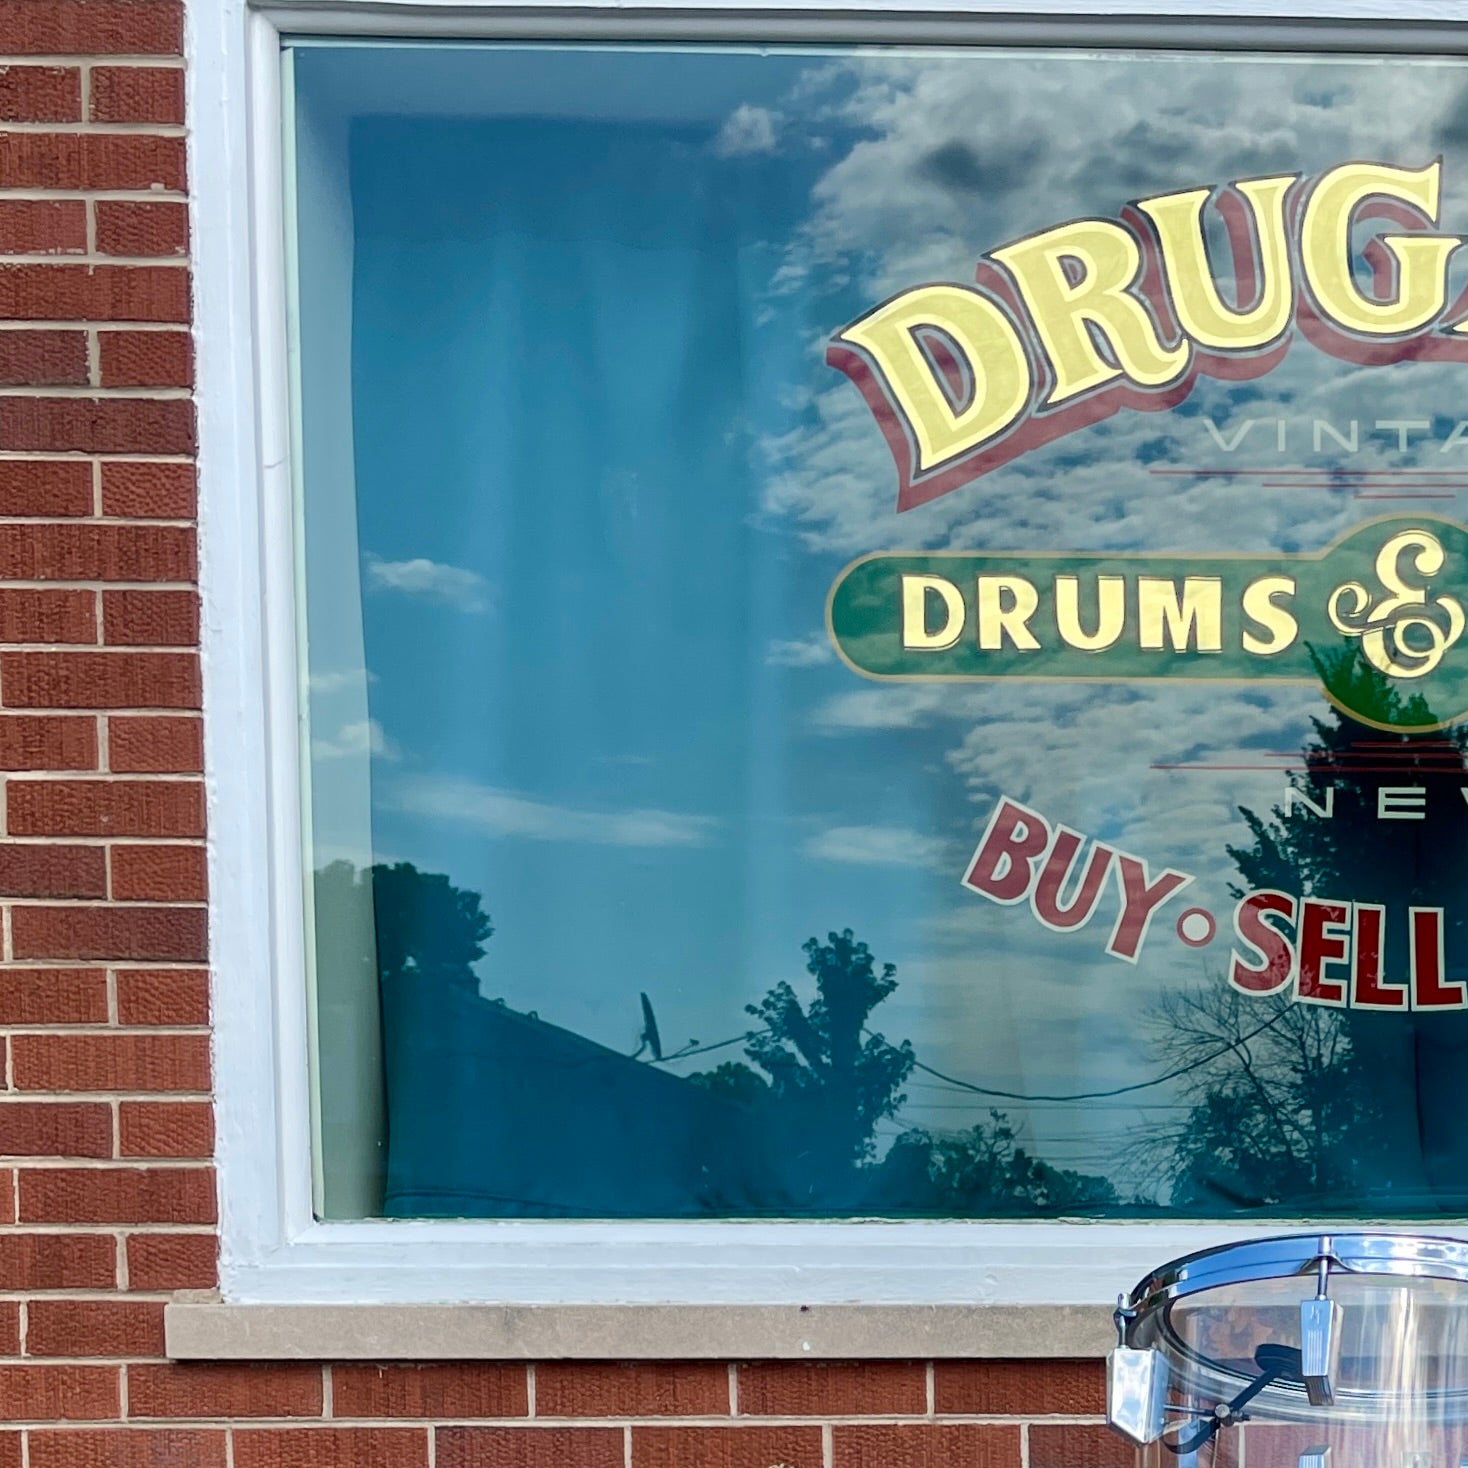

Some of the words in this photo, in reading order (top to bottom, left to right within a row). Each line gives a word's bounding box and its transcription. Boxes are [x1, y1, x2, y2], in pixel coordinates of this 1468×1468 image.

[900, 573, 1299, 657] DRUMS
[1328, 529, 1467, 680] &
[961, 795, 1196, 965] BUY
[1228, 888, 1468, 1012] SELL
